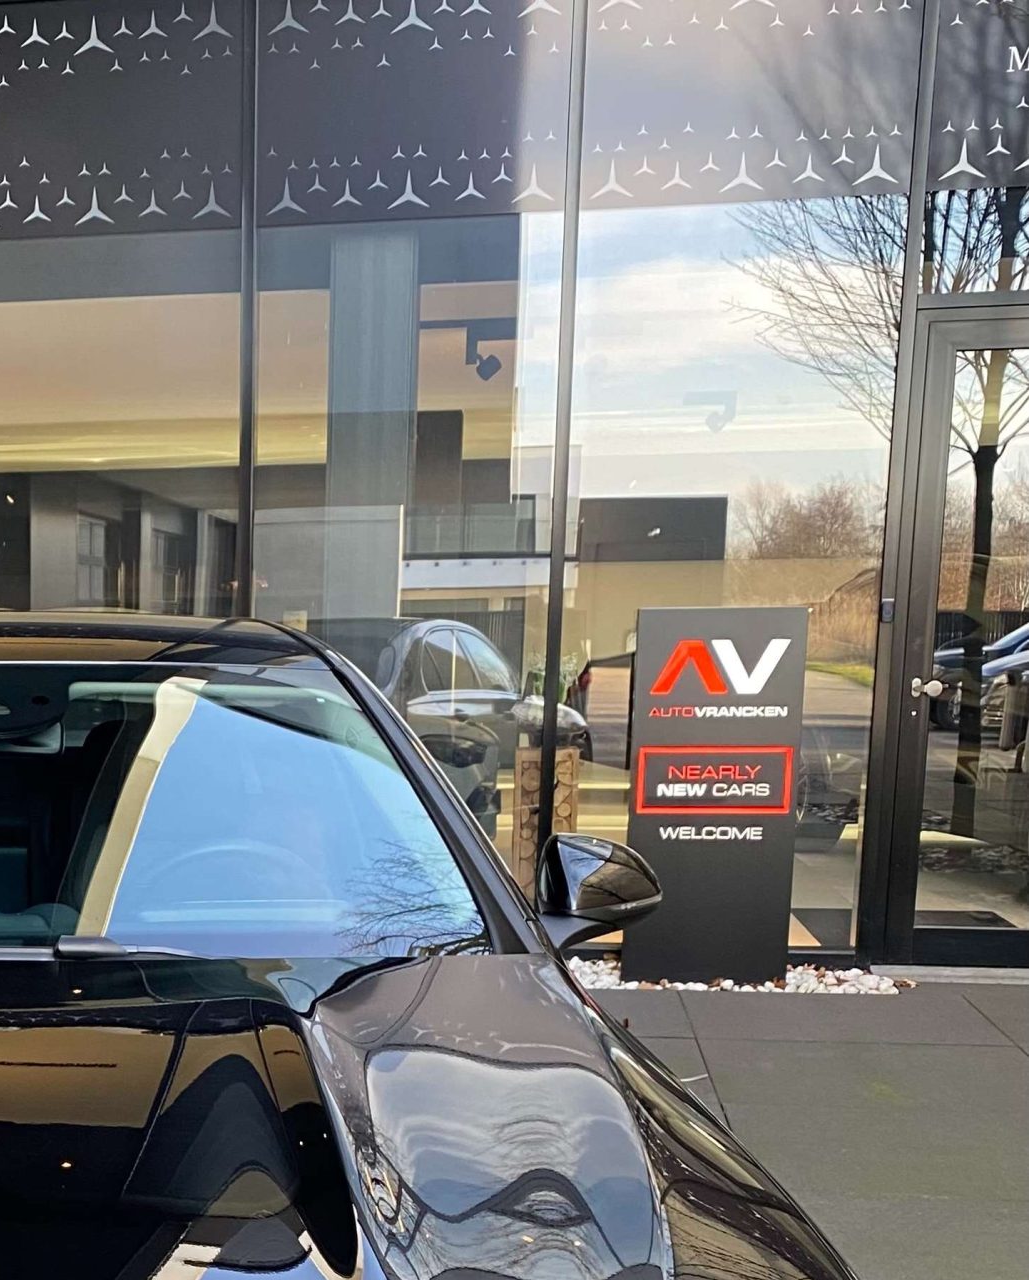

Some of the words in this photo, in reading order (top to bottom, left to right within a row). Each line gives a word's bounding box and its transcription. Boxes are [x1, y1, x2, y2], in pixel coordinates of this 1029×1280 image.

[649, 638, 792, 695] AV
[668, 765, 762, 780] NEARLY
[656, 783, 707, 797] NEW
[712, 783, 770, 797] CARS
[659, 826, 763, 840] WELCOME
